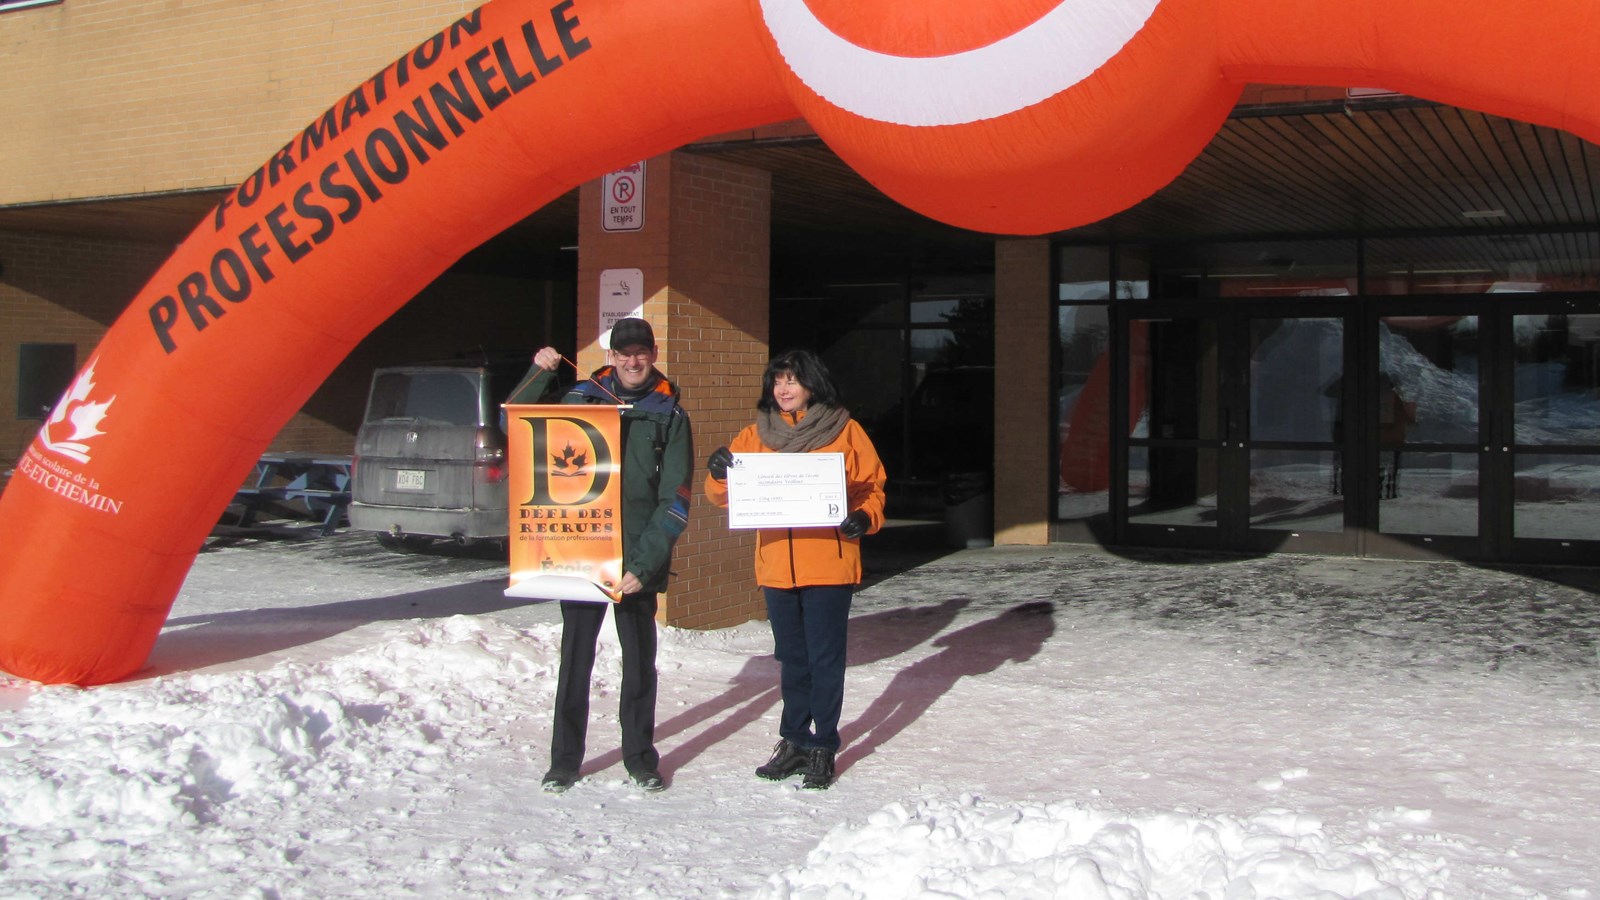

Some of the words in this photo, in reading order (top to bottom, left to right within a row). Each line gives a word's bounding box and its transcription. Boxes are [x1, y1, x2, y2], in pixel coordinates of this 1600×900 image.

[215, 7, 482, 233] FORMATION
[148, 0, 592, 355] PROFESSIONNELLE
[613, 215, 633, 223] TEMPS
[41, 455, 73, 478] scolaire
[73, 472, 87, 485] de
[88, 477, 100, 491] la
[519, 505, 568, 519] DÉFI
[578, 508, 613, 519] DES
[519, 522, 613, 533] RECRUES
[541, 556, 592, 574] École
